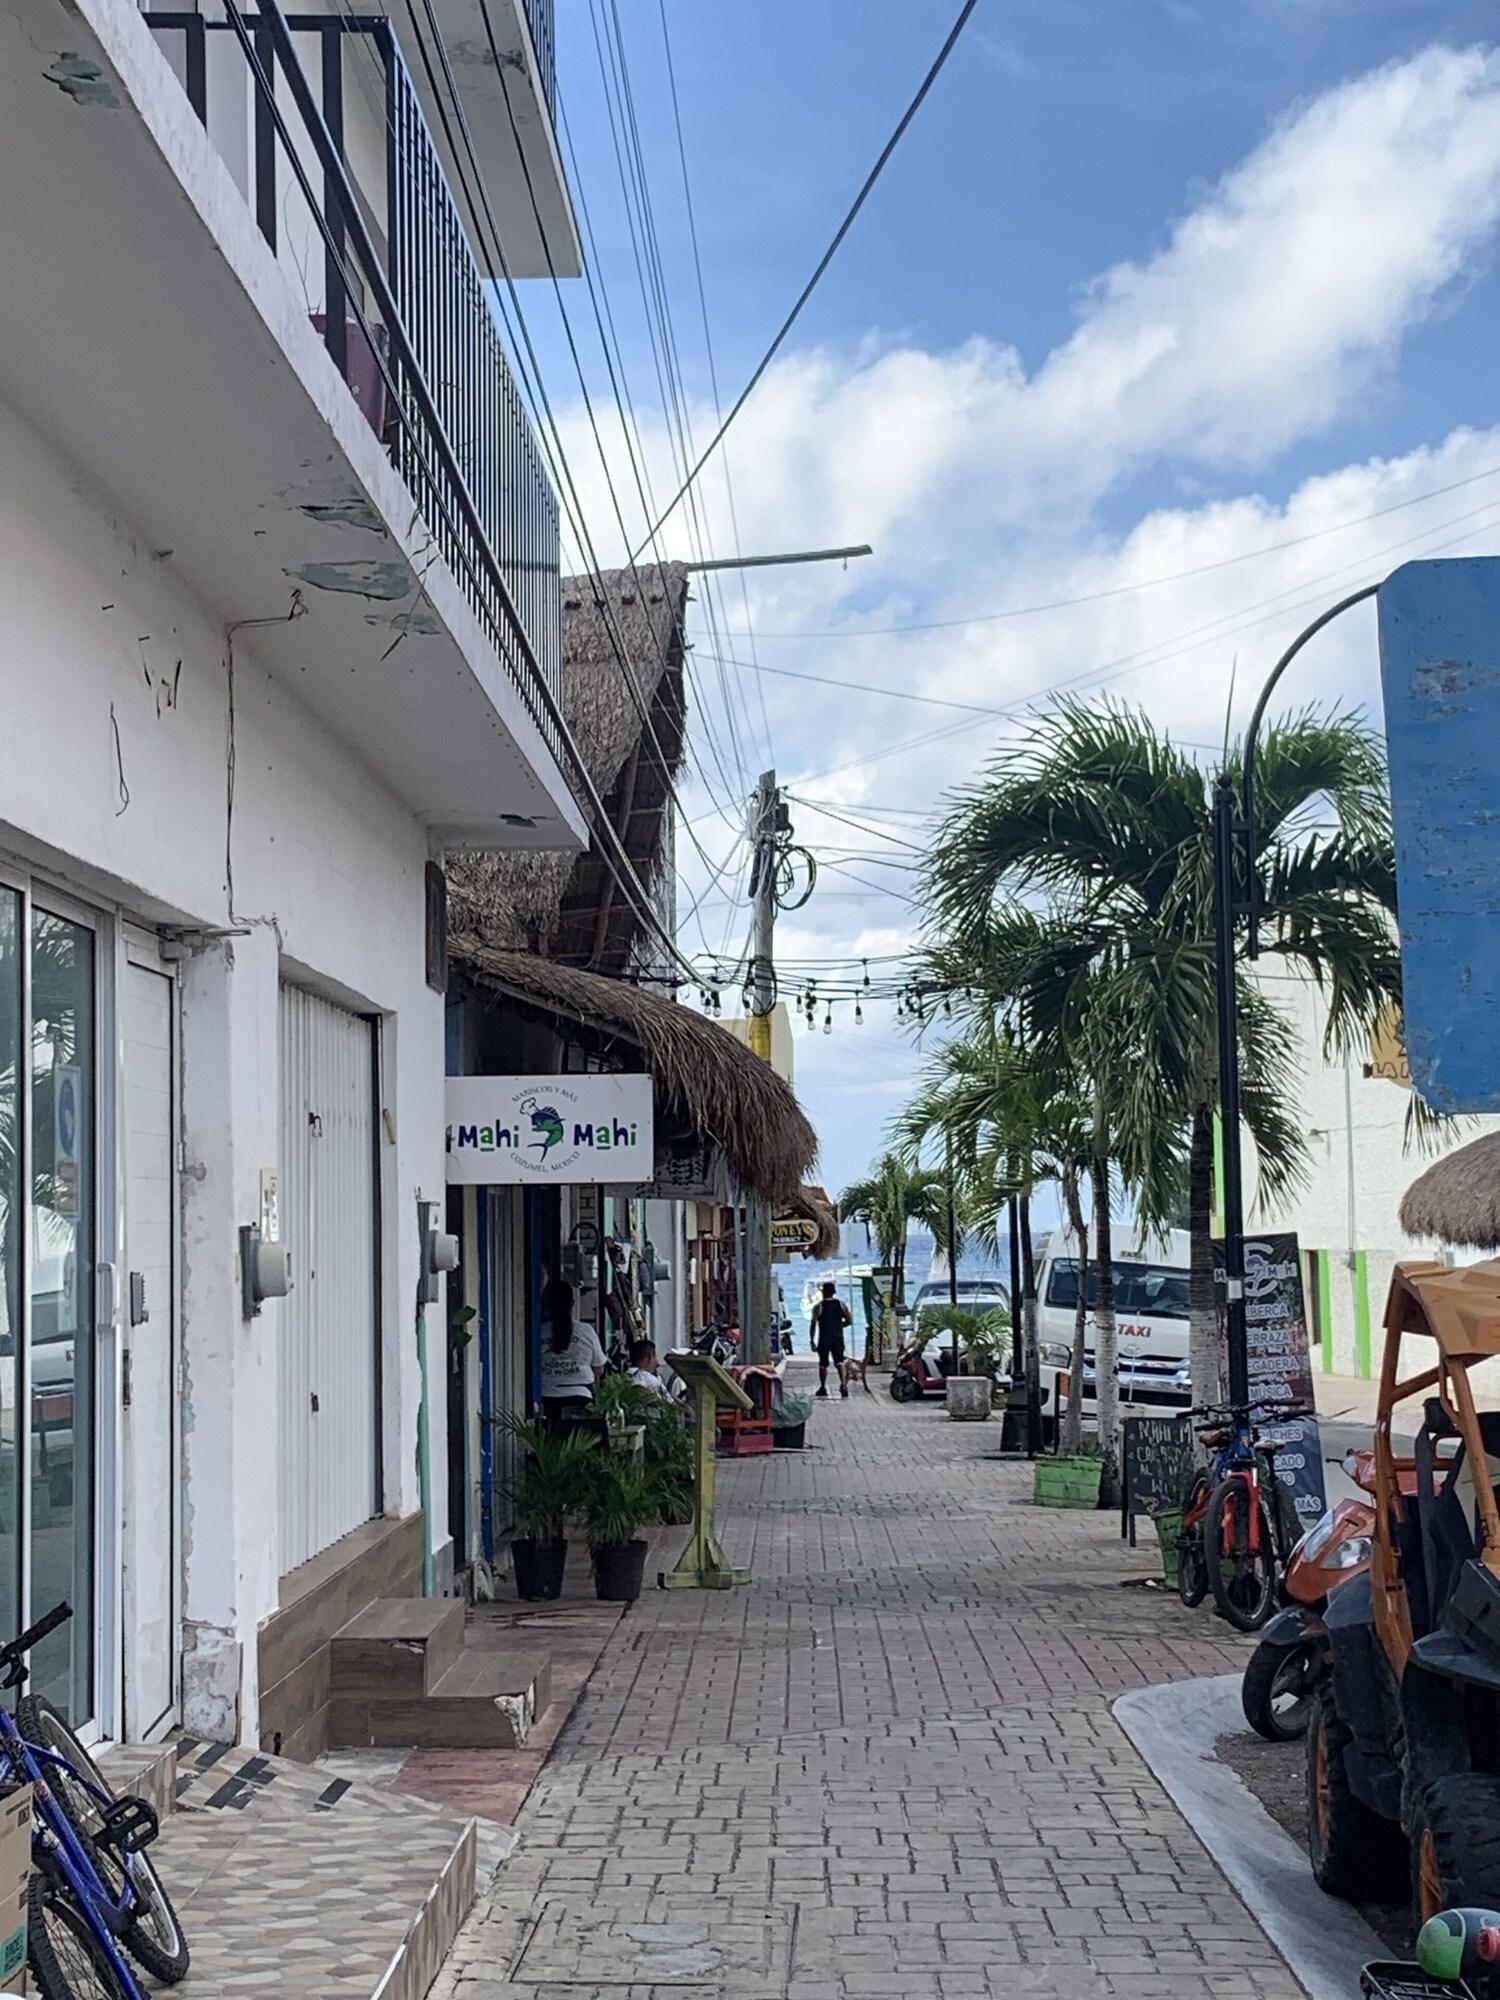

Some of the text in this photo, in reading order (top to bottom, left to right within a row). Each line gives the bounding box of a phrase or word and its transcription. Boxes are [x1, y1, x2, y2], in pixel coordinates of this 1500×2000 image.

[458, 1117, 637, 1150] Mahi Mahi
[1117, 1323, 1152, 1338] TAXI
[1246, 1330, 1290, 1345] ERRAZA
[1247, 1357, 1298, 1373] EGADERA
